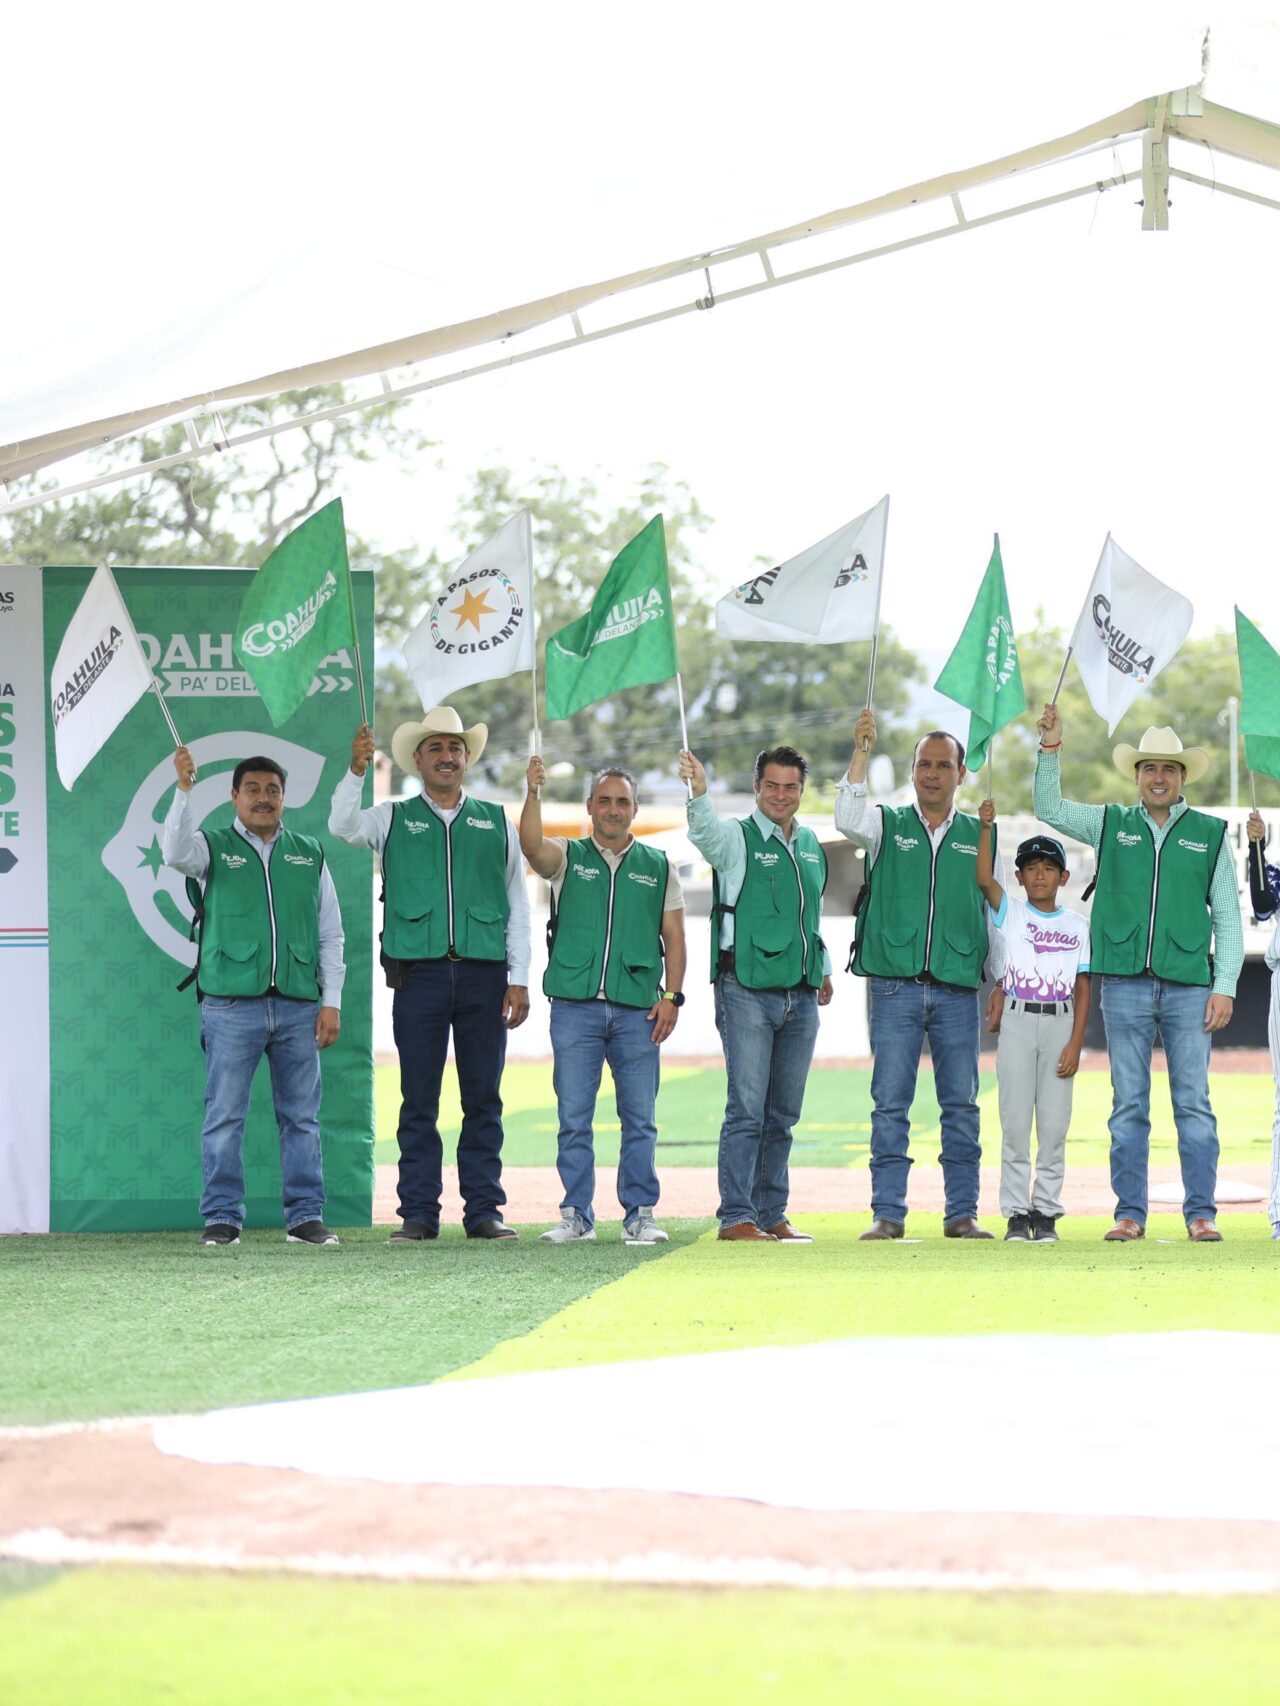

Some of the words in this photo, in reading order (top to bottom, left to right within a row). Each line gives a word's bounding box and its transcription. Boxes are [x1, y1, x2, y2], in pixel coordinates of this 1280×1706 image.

[437, 596, 448, 607] A
[447, 568, 501, 594] PASOS
[435, 638, 455, 655] DE
[458, 607, 523, 655] GIGANTE
